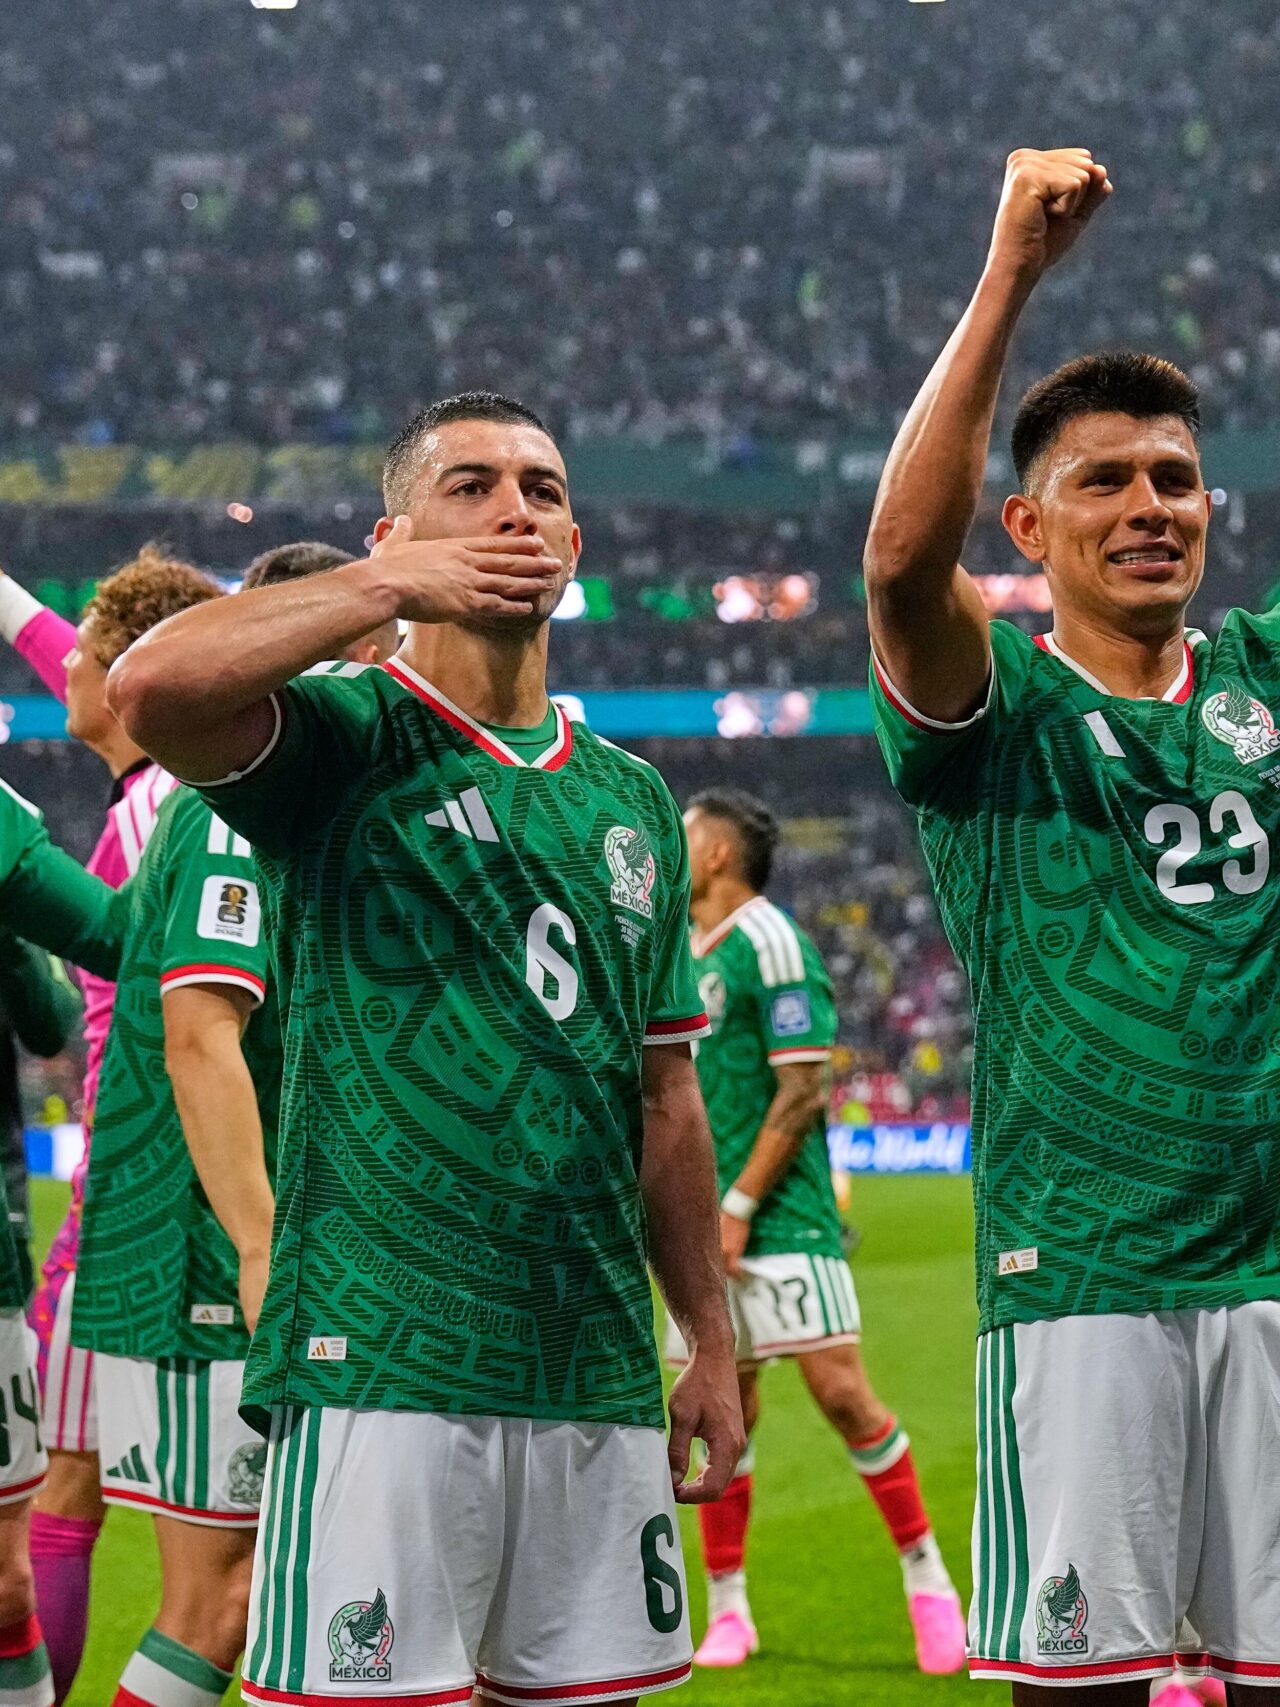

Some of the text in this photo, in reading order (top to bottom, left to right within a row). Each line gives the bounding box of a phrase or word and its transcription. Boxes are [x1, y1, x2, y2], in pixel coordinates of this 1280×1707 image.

[1144, 790, 1269, 904] 23
[611, 888, 651, 915] MÉXICO
[526, 903, 578, 1020] 6
[641, 1513, 682, 1633] 6
[332, 1664, 388, 1678] MÉXICO
[1038, 1638, 1085, 1652] MÉXICO
